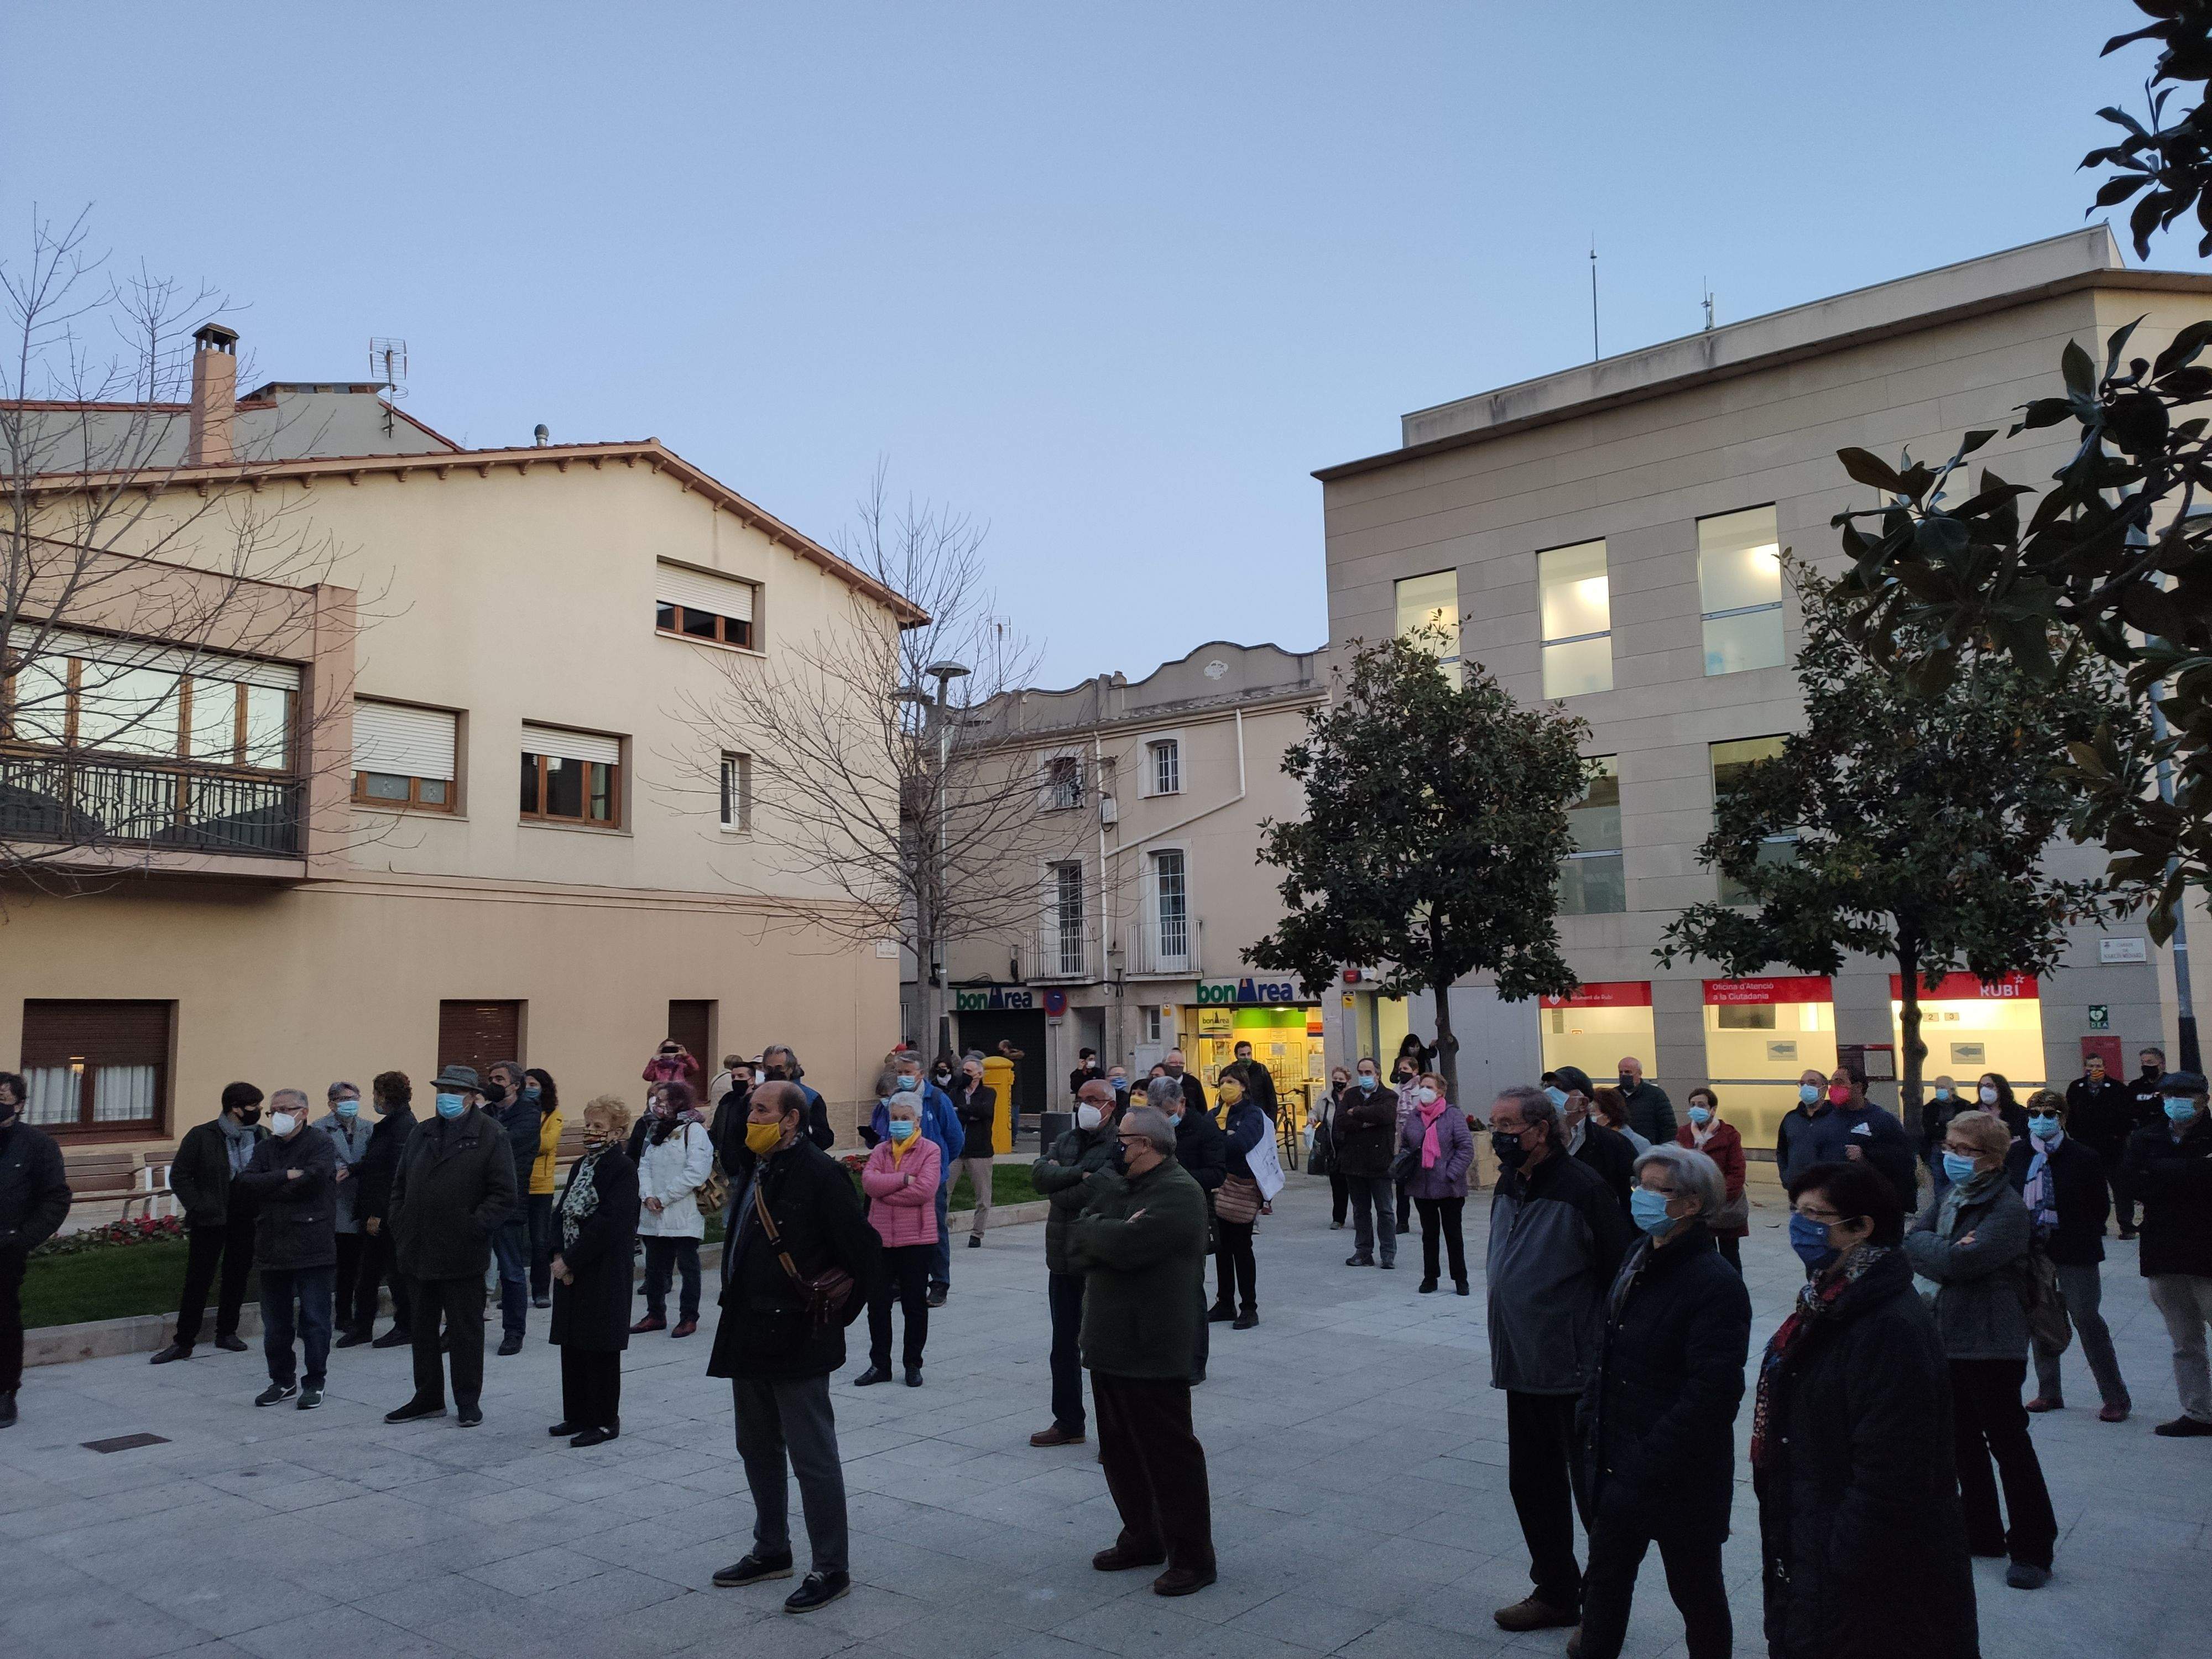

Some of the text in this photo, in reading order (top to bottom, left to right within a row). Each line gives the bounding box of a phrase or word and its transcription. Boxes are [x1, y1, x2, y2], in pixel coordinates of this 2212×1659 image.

[957, 987, 1032, 1010] bonArea
[1197, 978, 1293, 1004] bonArea
[1202, 1011, 1229, 1024] bonArea
